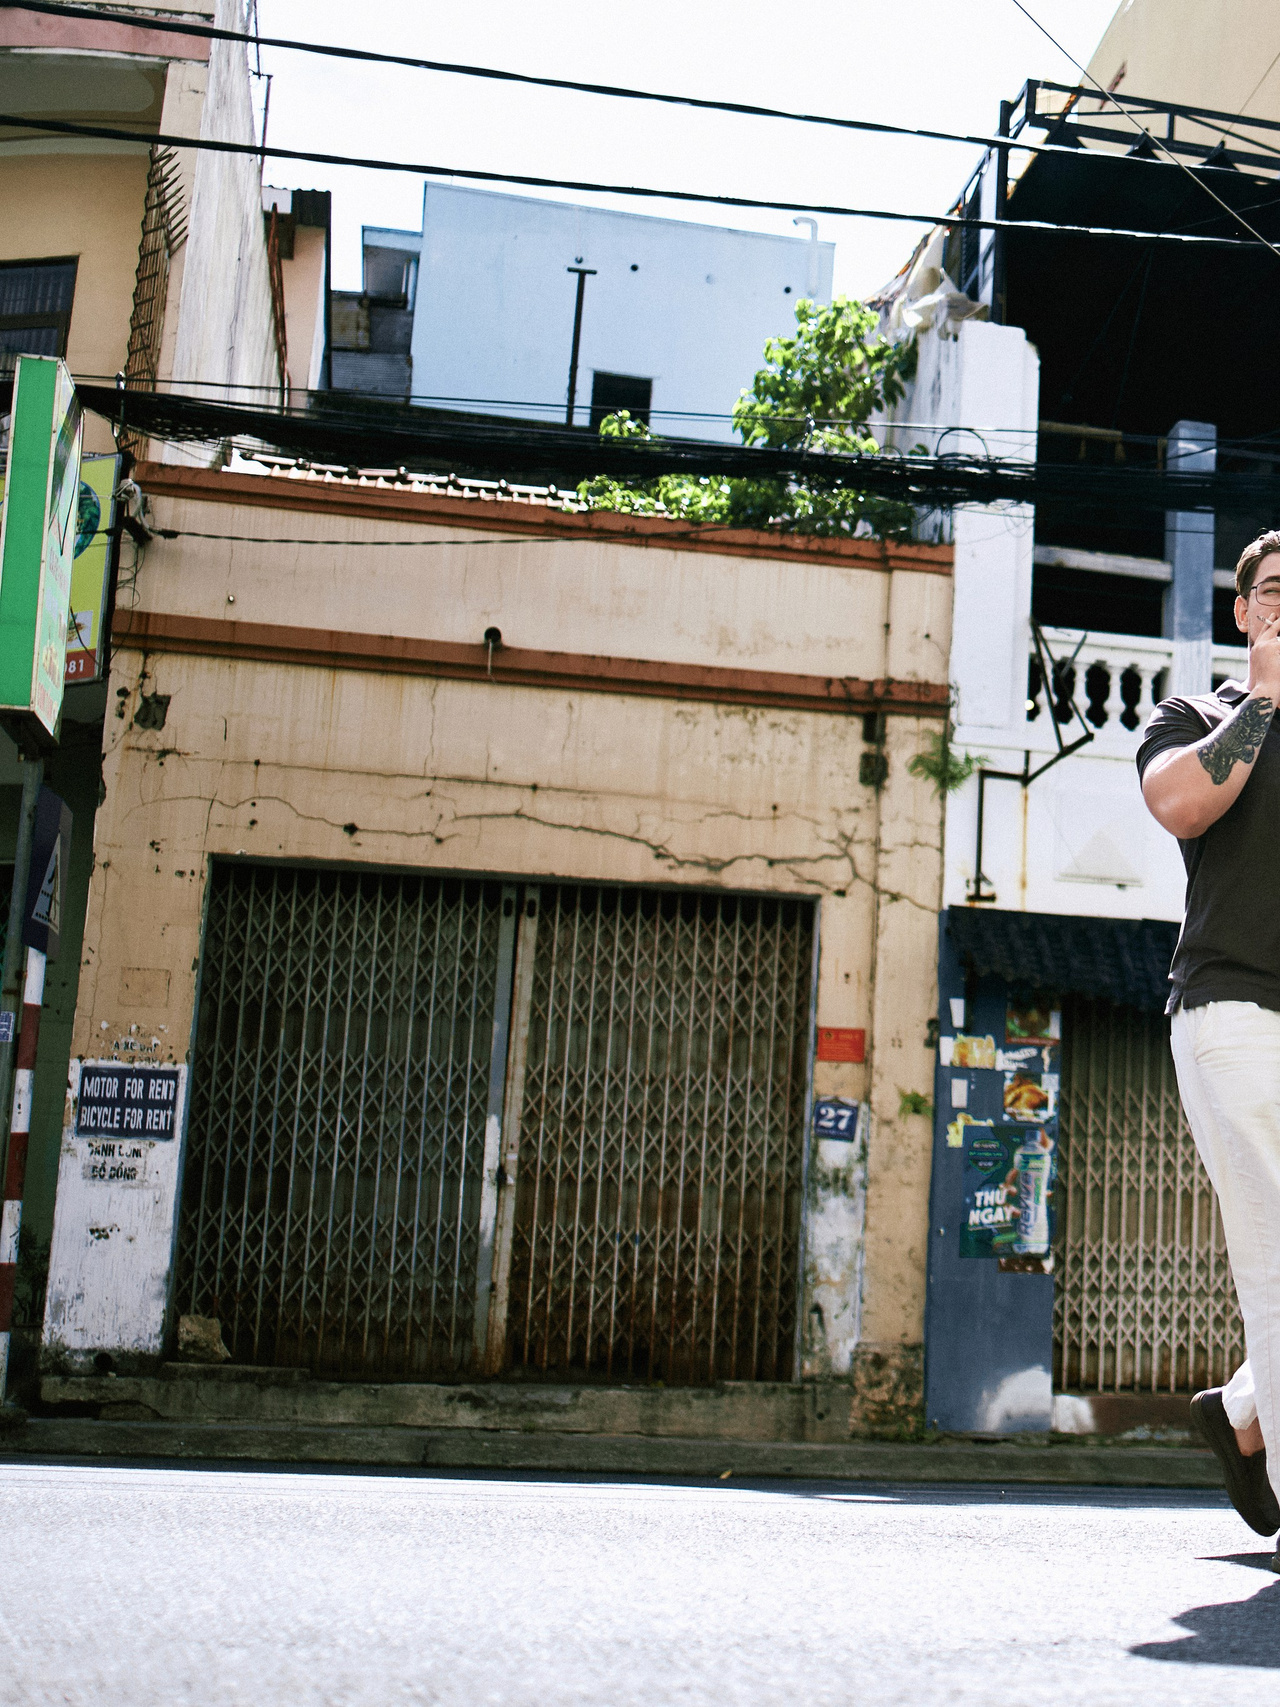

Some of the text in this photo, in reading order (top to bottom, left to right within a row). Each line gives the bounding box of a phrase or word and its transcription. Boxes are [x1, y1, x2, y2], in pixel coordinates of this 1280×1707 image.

[83, 1076, 175, 1101] MOTOR FOR RENT
[80, 1106, 173, 1130] BICYCLE FOR RENT
[818, 1106, 853, 1131] 27
[968, 1205, 1013, 1226] NGAY
